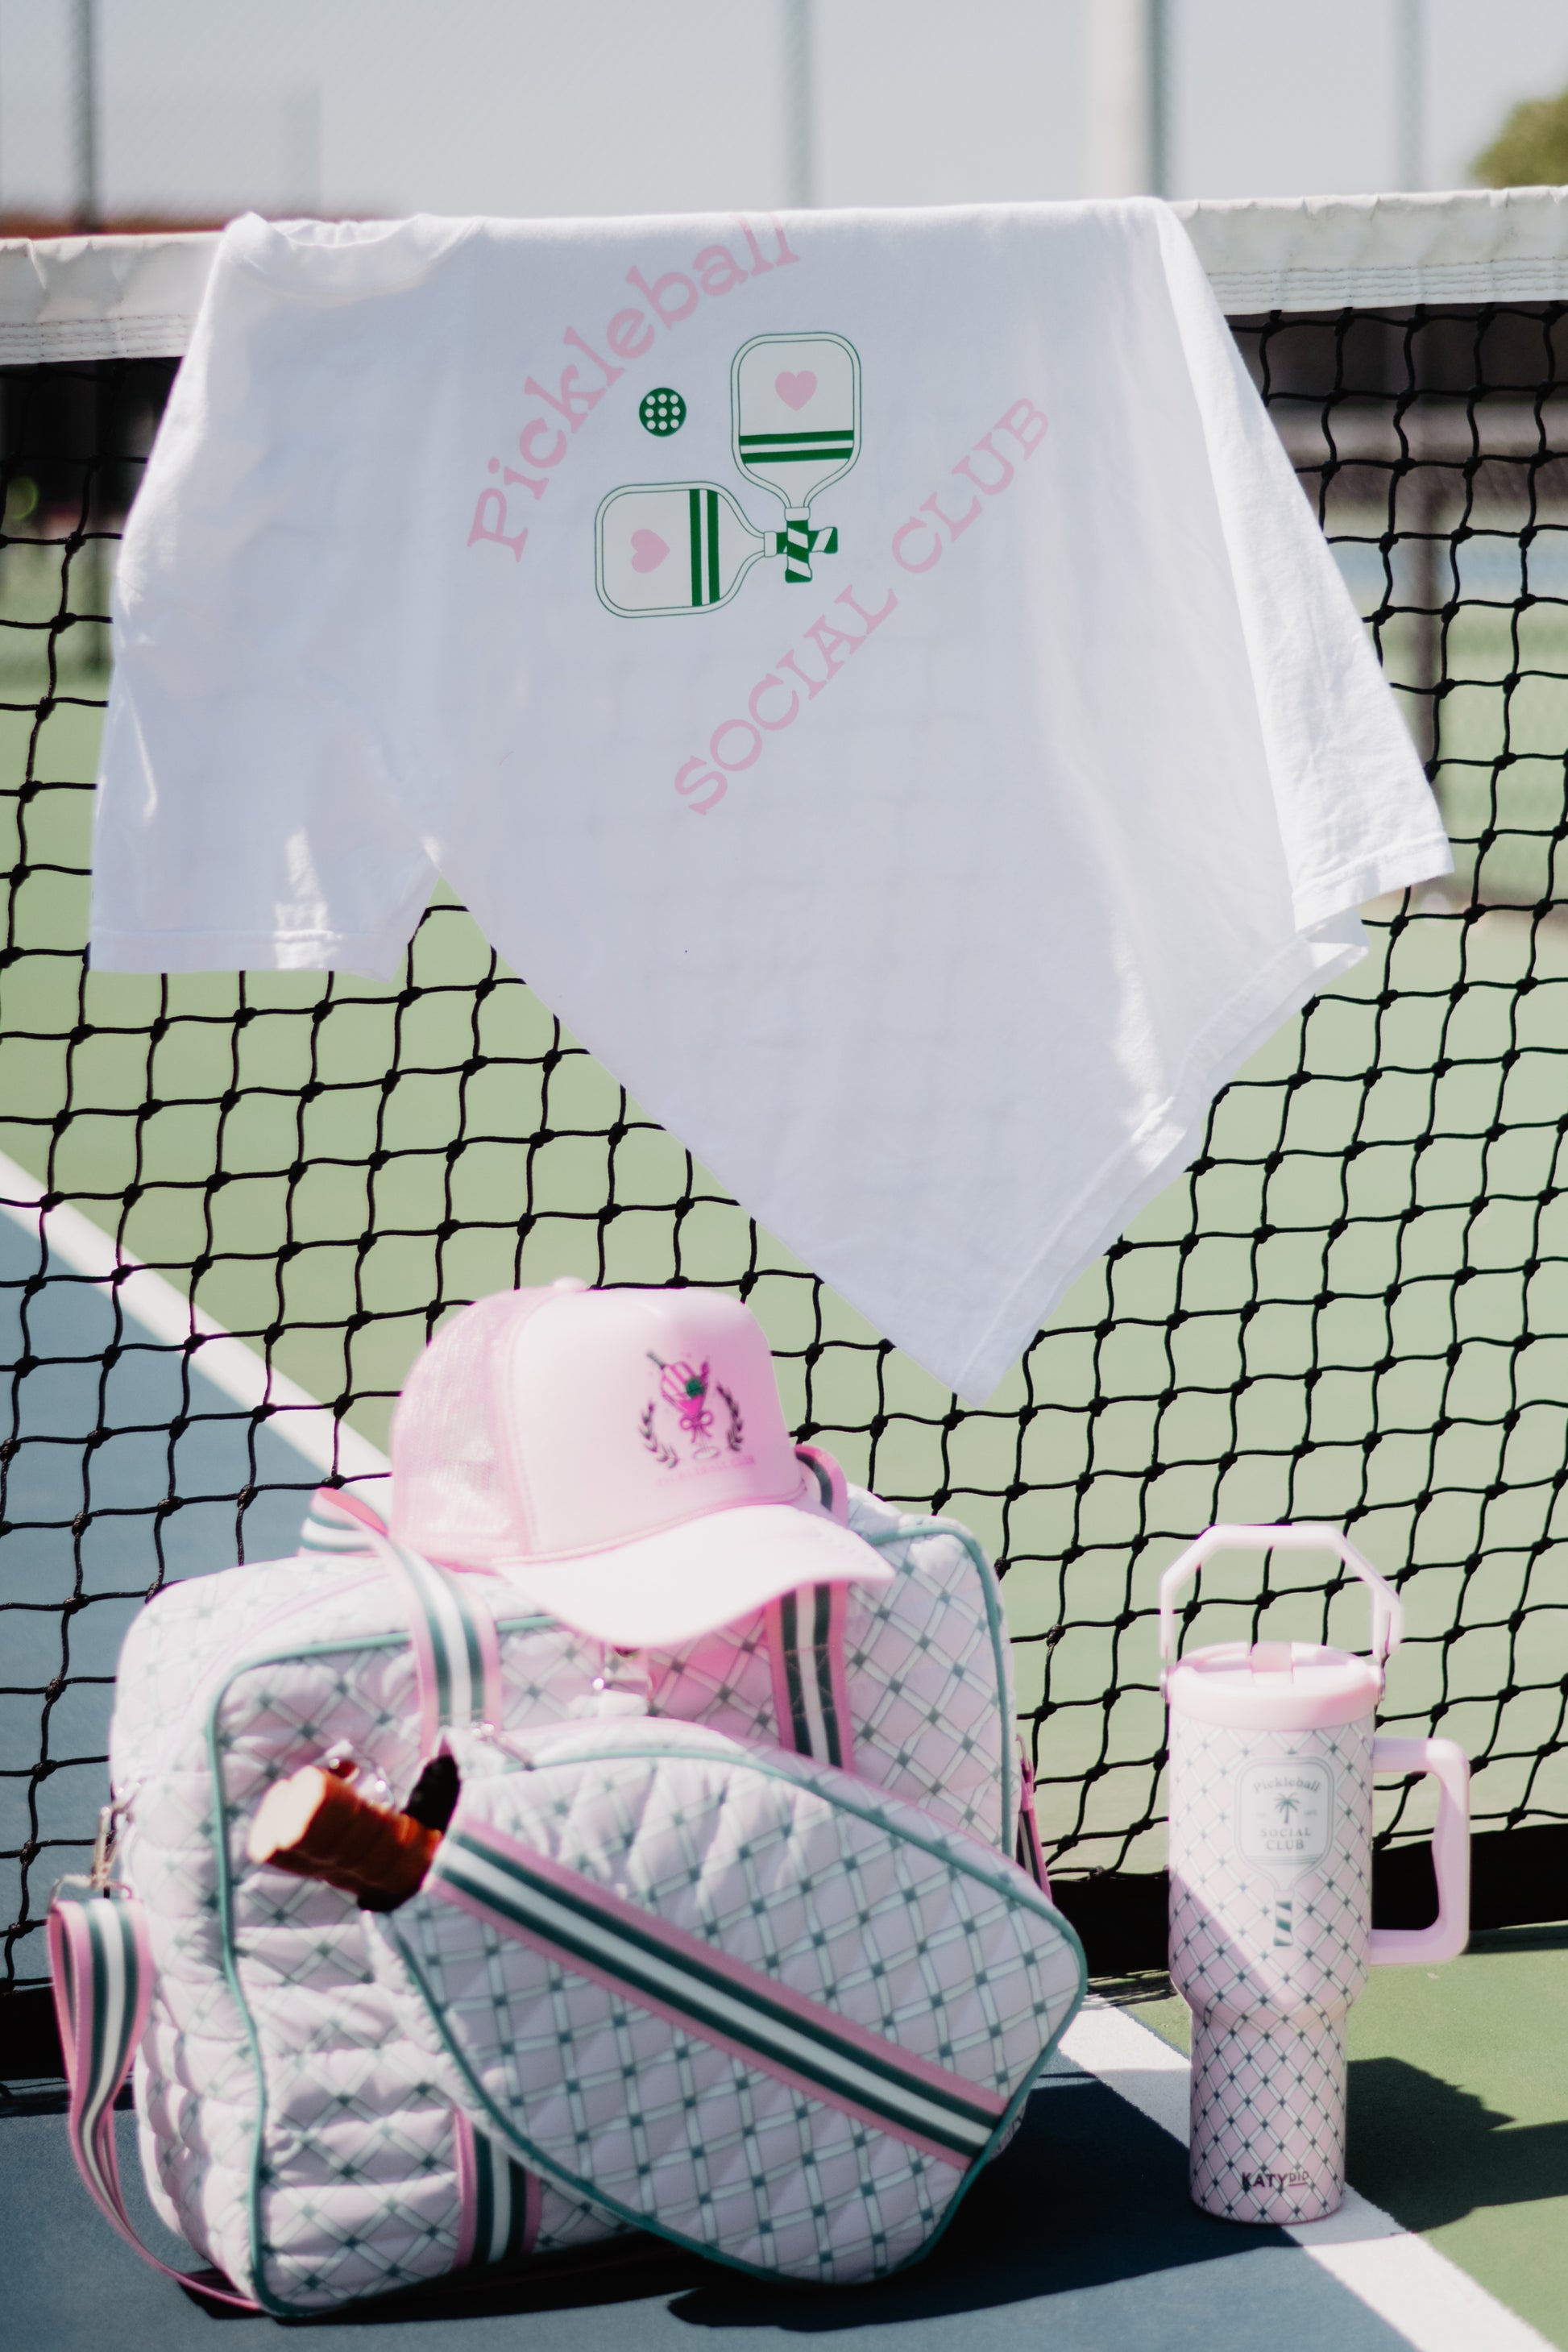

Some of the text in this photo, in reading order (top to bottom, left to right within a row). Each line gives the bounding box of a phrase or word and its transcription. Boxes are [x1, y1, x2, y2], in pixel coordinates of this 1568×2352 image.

[467, 213, 800, 562] Pickleball
[674, 397, 1050, 815] SOCIAL CLUB
[1253, 1776, 1321, 1793] Pickleball
[1260, 1827, 1311, 1837] SOCIAL
[1266, 1839, 1305, 1850] CLUB
